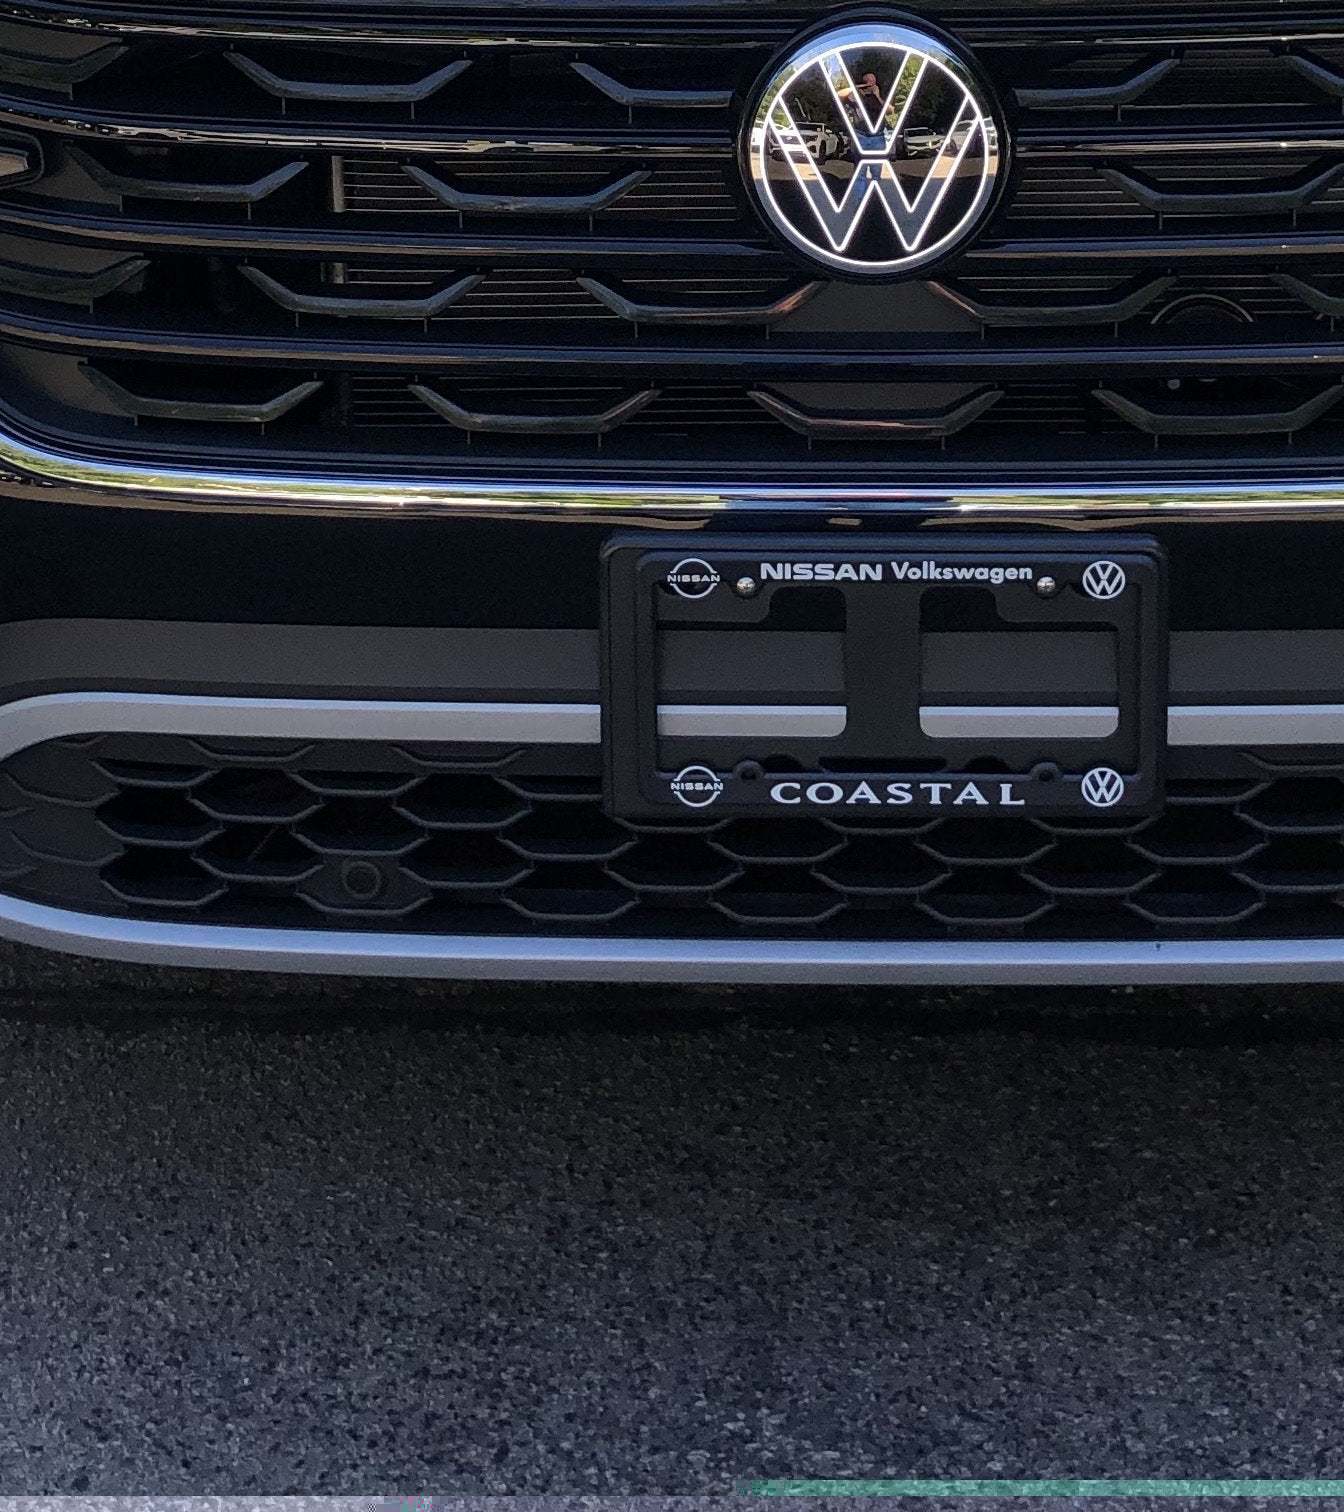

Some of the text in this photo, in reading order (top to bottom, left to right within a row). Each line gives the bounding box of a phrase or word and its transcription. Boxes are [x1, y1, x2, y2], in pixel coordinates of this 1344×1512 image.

[667, 574, 720, 583] NISSAN
[760, 561, 1033, 584] NISSAN Volkswagen
[670, 782, 724, 791] NISSAN
[770, 781, 1025, 806] COASTAL
